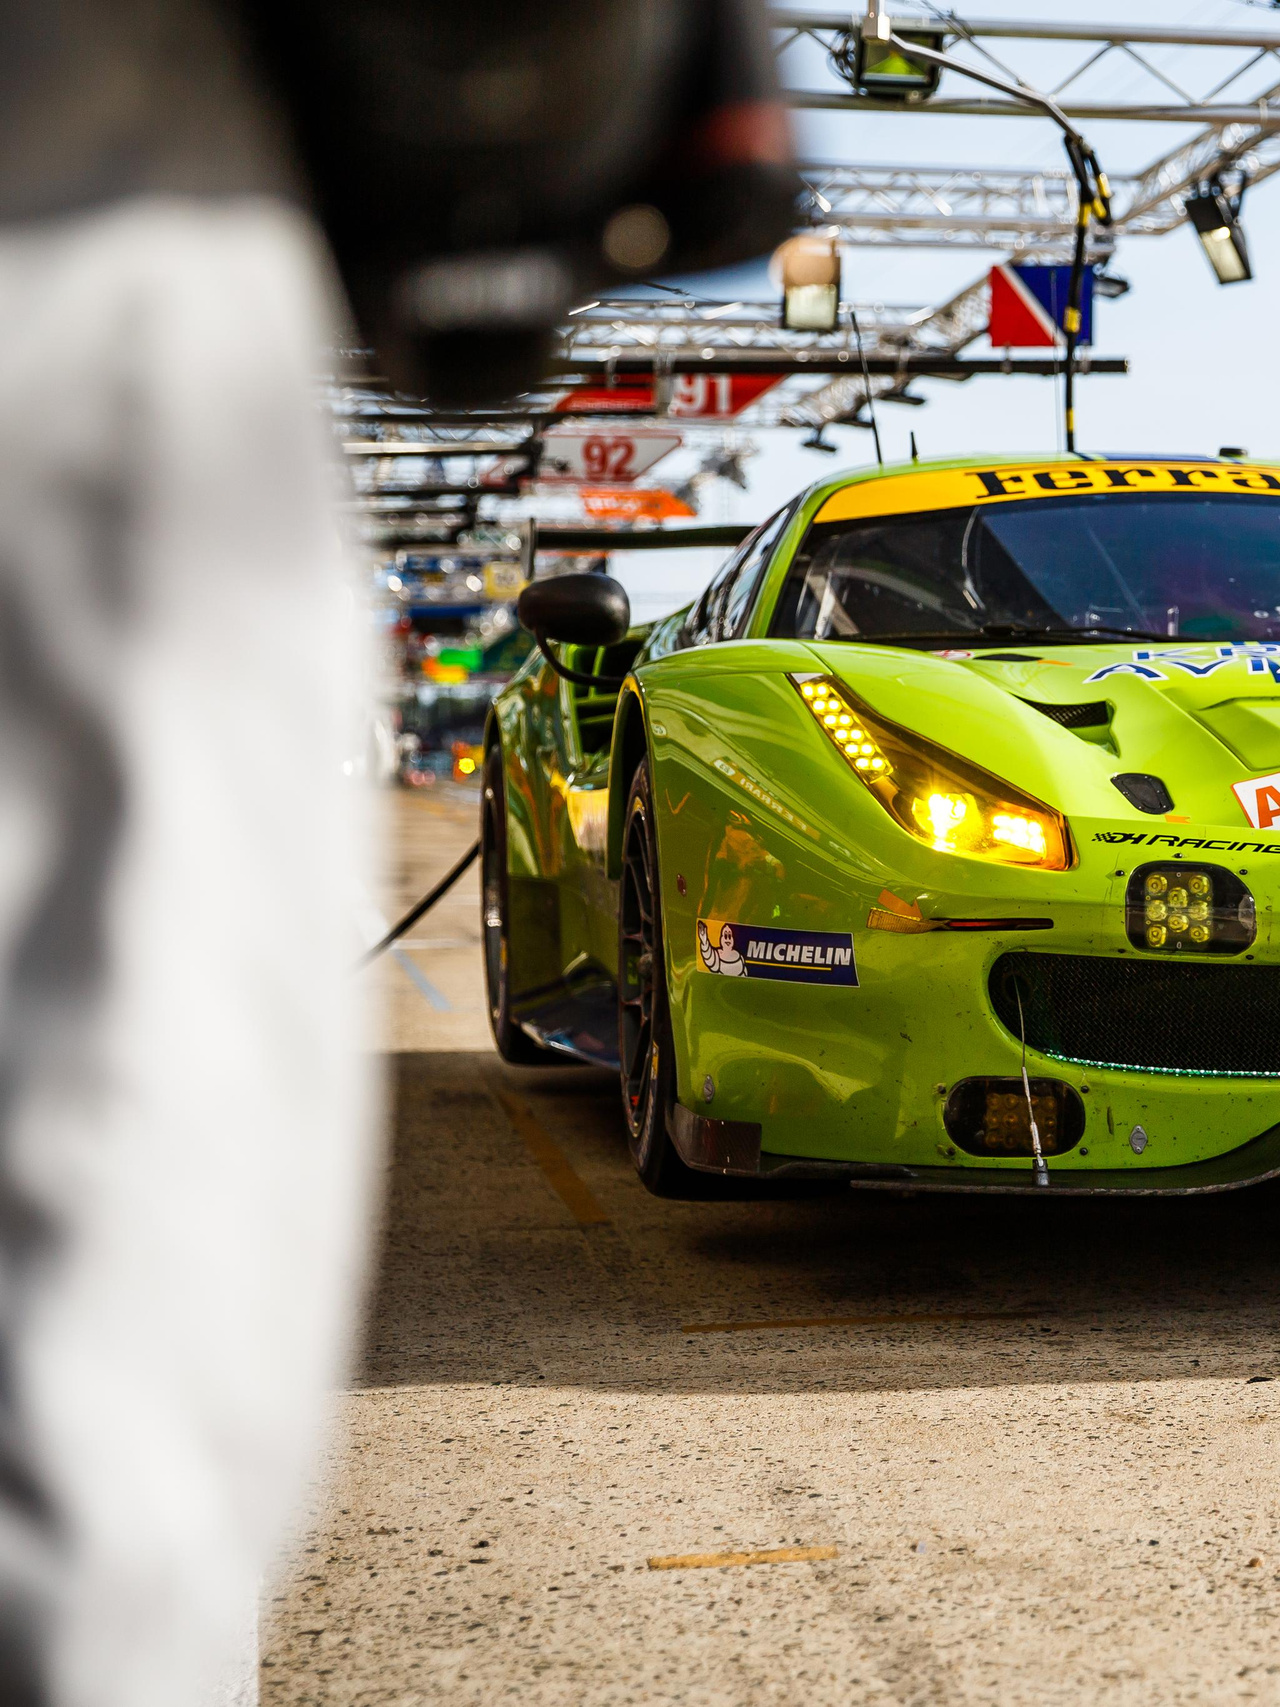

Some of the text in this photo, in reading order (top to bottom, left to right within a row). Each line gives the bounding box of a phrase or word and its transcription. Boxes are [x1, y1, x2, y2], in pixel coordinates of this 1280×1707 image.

[674, 373, 732, 414] 91
[582, 435, 636, 480] 92
[746, 940, 852, 966] MICHELIN
